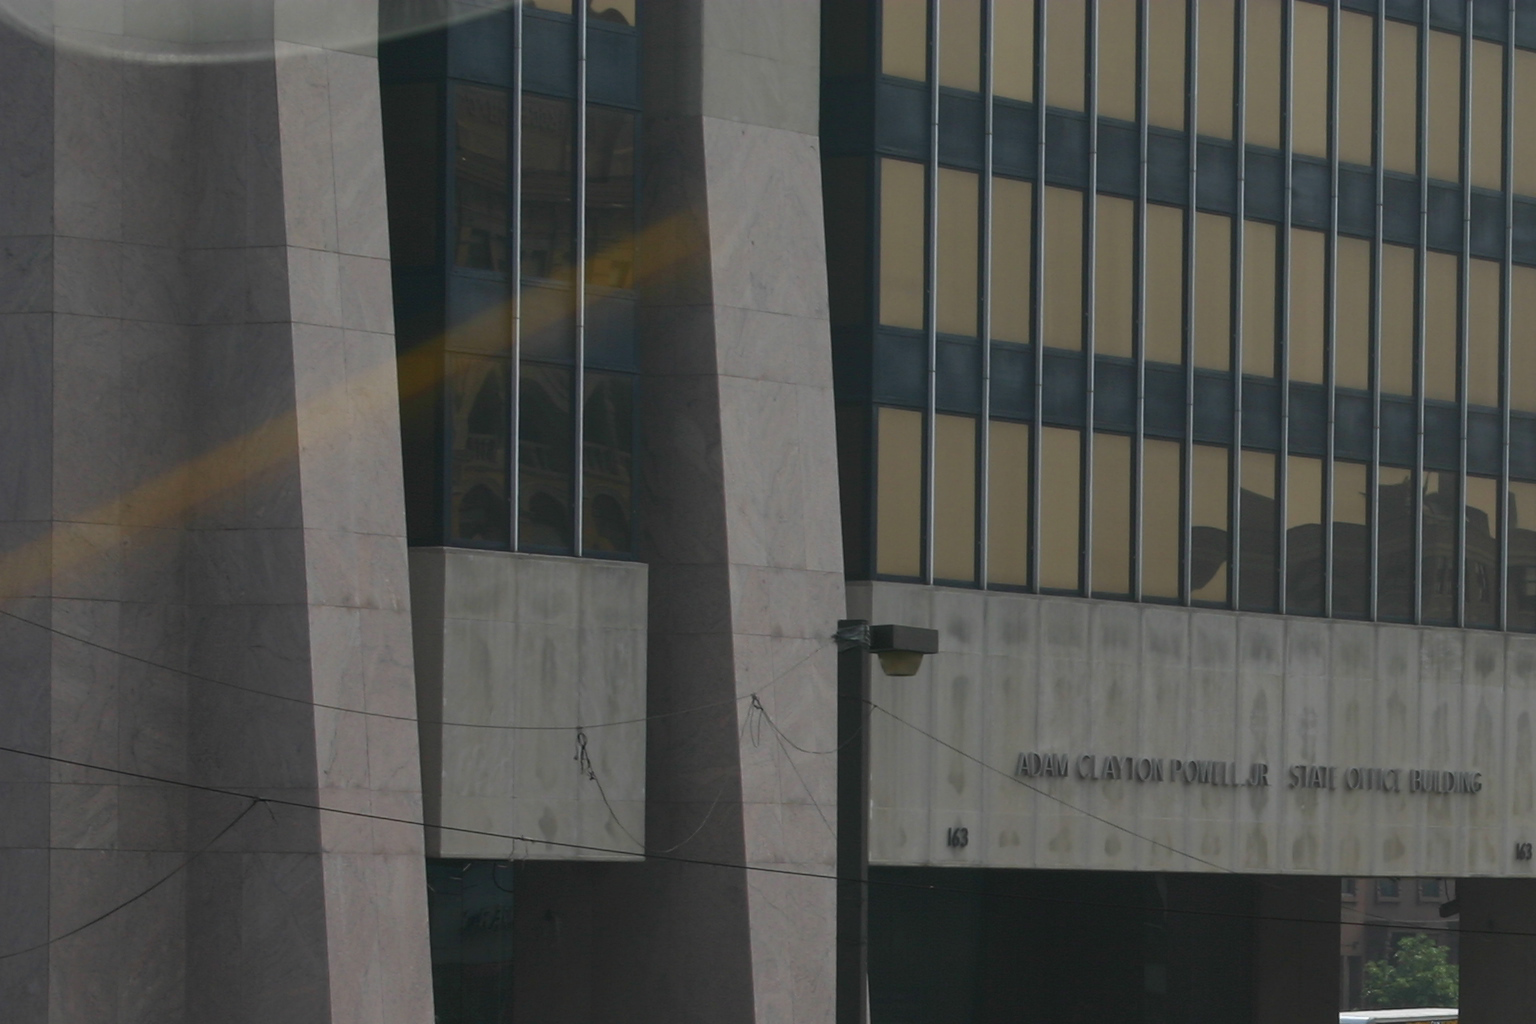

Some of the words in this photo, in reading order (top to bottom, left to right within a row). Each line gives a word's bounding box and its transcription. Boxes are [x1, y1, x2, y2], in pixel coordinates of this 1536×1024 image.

[1015, 751, 1069, 778] ADAM
[1076, 754, 1164, 783] CLAYTON
[1288, 765, 1336, 791] STATE
[1344, 767, 1401, 793] OFFICE
[1409, 769, 1483, 794] BUILDING
[946, 827, 969, 848] 163
[1515, 842, 1533, 861] 163
